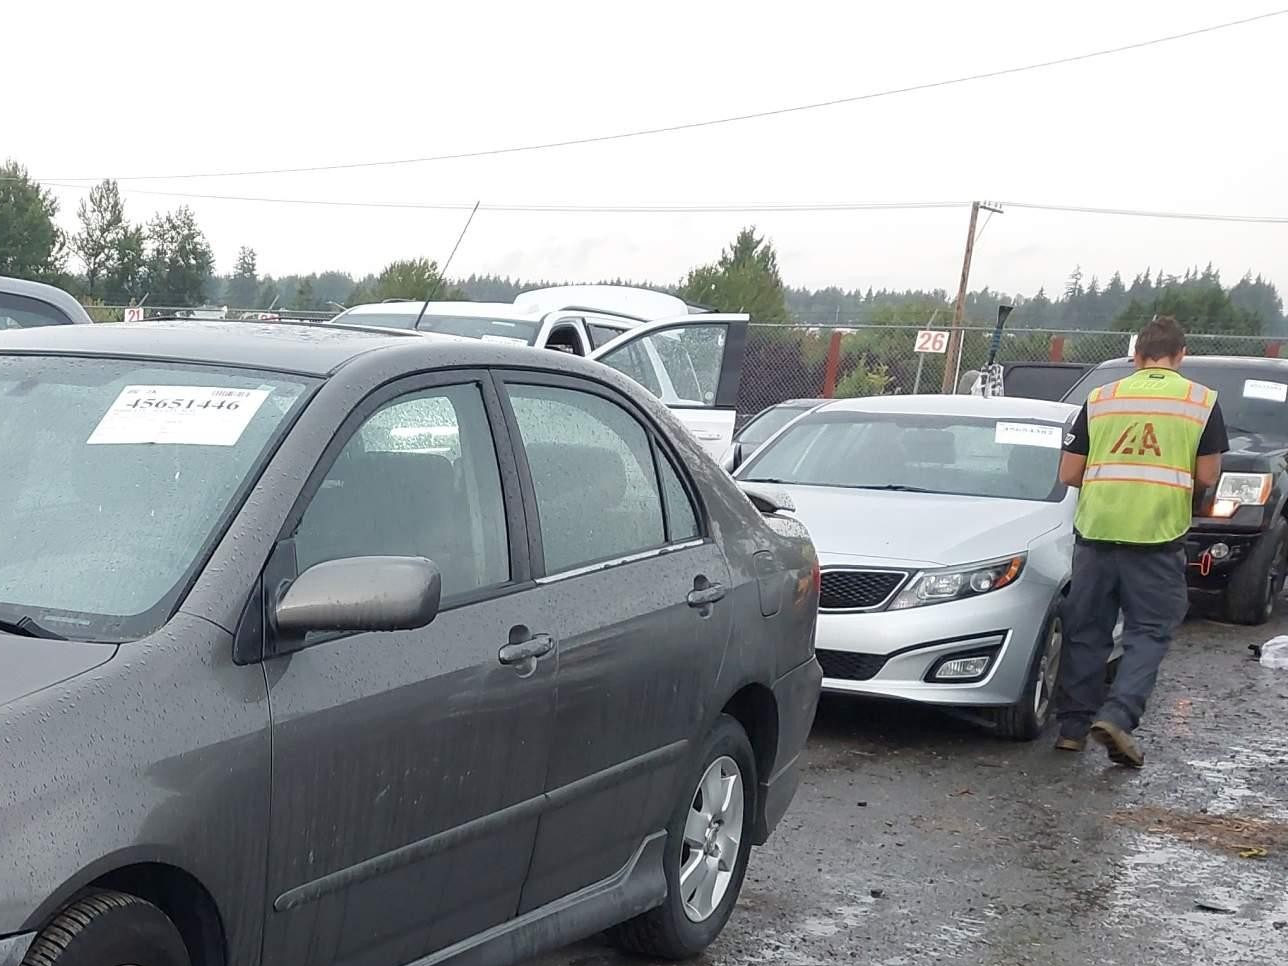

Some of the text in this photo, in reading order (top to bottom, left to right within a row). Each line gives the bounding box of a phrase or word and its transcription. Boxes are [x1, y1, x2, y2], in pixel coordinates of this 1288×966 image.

[128, 309, 140, 322] 21
[918, 332, 945, 351] 26
[126, 398, 240, 411] 45651446
